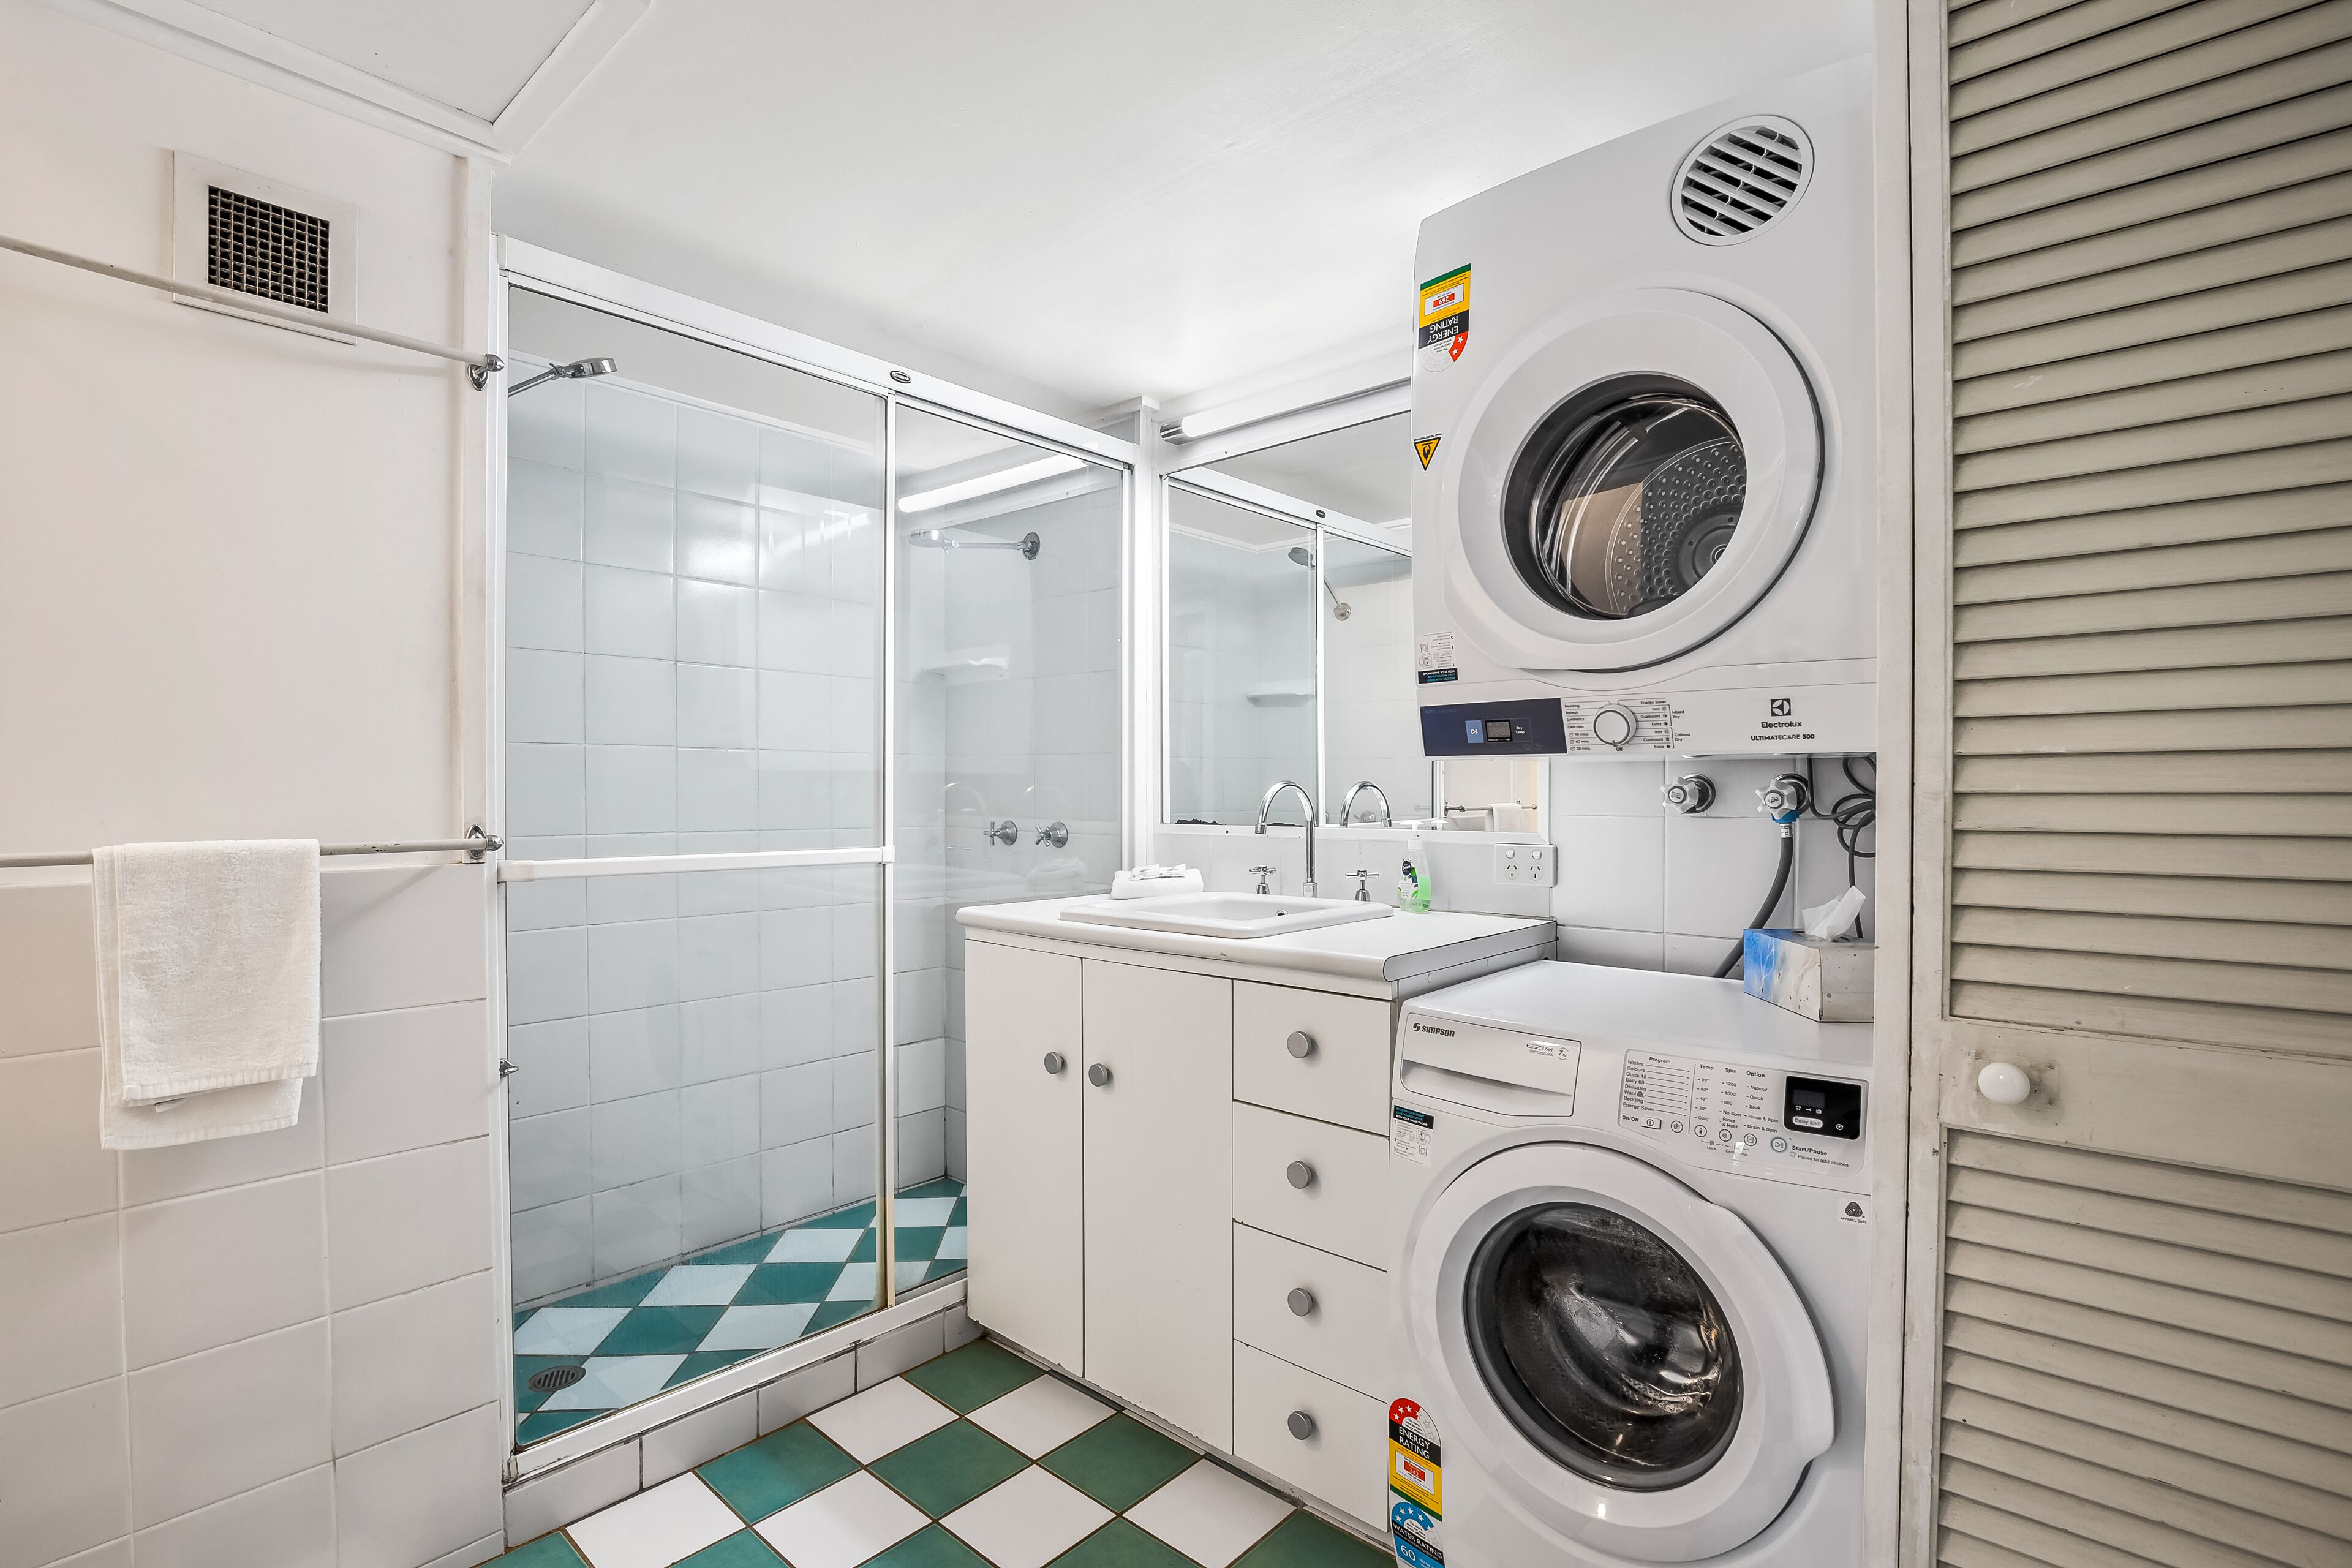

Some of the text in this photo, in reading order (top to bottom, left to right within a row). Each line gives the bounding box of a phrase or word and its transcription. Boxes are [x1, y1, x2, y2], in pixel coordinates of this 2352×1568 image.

[1439, 296, 1449, 305] 269
[1430, 316, 1458, 333] RATING
[1427, 326, 1458, 344] ENERGY
[1422, 1025, 1455, 1038] SIMPSON
[1792, 1145, 1827, 1155] Start/Pause
[1399, 1426, 1430, 1449] ENERGY
[1400, 1436, 1430, 1459] RATING
[1410, 1468, 1419, 1477] 342
[1393, 1523, 1415, 1542] WATER
[1417, 1539, 1442, 1559] RATING
[1401, 1545, 1415, 1561] 60
